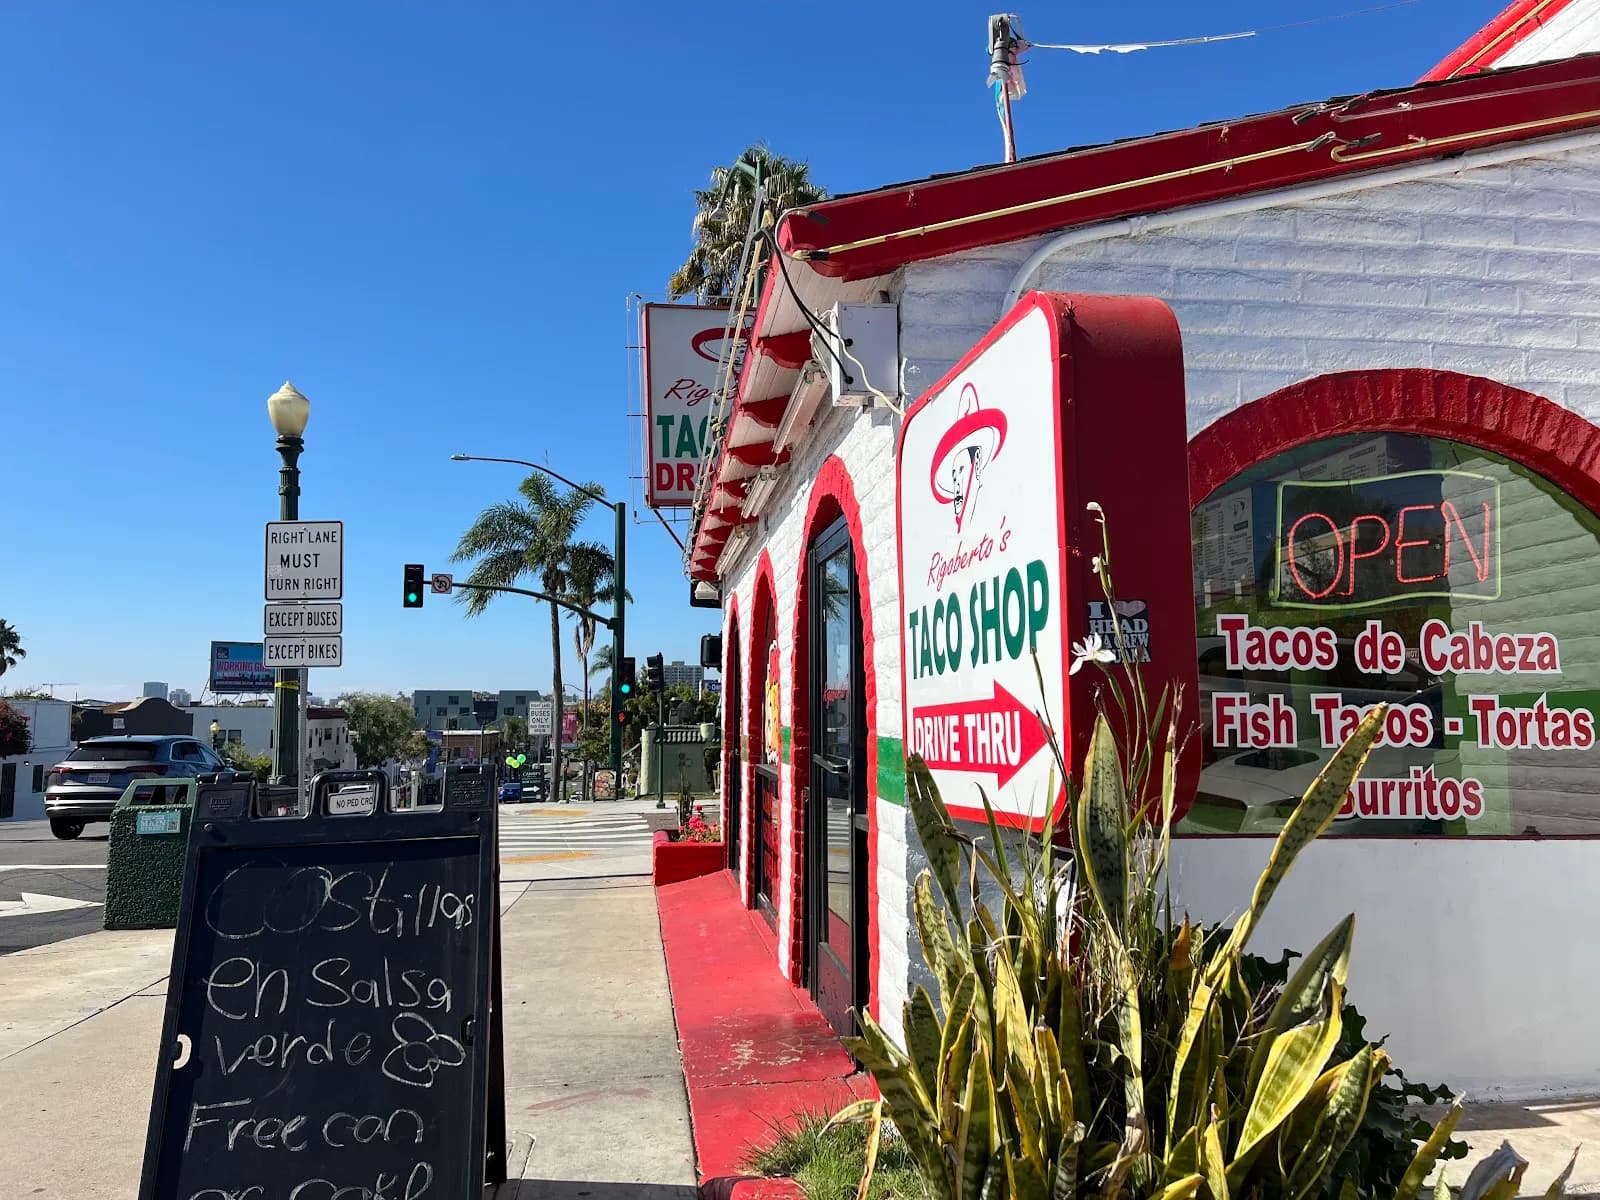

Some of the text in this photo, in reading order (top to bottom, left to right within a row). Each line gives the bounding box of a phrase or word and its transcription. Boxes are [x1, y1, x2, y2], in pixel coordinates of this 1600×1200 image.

[271, 531, 337, 544] RIGHT LANE
[927, 515, 1011, 592] Rigoberto's
[1287, 500, 1490, 599] OPEN
[280, 553, 320, 568] MUST
[270, 577, 338, 591] TURN RIGHT
[269, 611, 337, 627] EXCEPT BUSES
[909, 559, 1050, 680] TACO SHOP
[1089, 619, 1148, 634] HEAD
[268, 644, 337, 660] EXCEPT BIKES
[1217, 614, 1562, 674] Tacos de Cabeza
[1212, 692, 1297, 747] Fish
[1467, 692, 1596, 750] Tortas
[914, 711, 1021, 766] DRIVE THRU
[336, 799, 346, 808] NO
[347, 798, 359, 807] PED
[184, 1098, 308, 1151] Free
